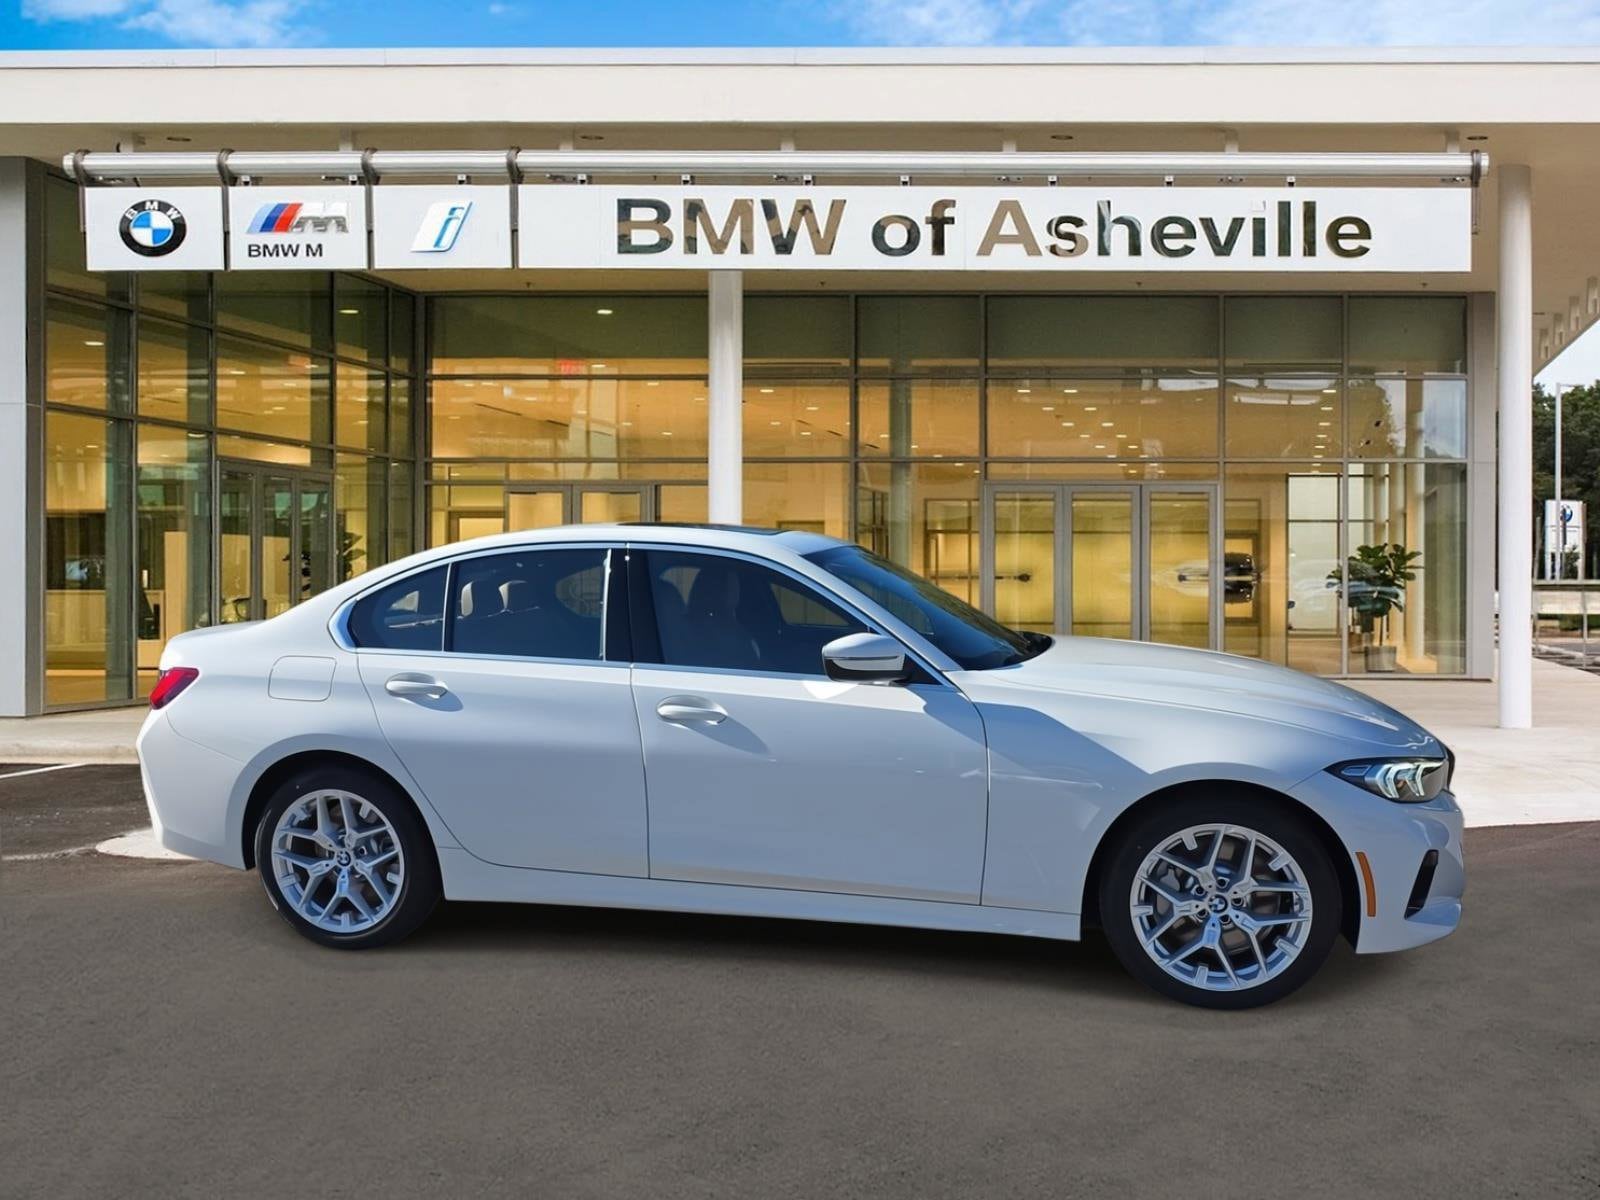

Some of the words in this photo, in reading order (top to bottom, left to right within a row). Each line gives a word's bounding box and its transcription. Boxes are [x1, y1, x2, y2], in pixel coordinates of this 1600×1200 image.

[125, 201, 180, 219] BMW
[616, 198, 847, 255] BMW
[871, 199, 956, 256] of
[976, 199, 1372, 257] Asheville
[248, 244, 300, 258] BMW
[306, 244, 323, 258] M
